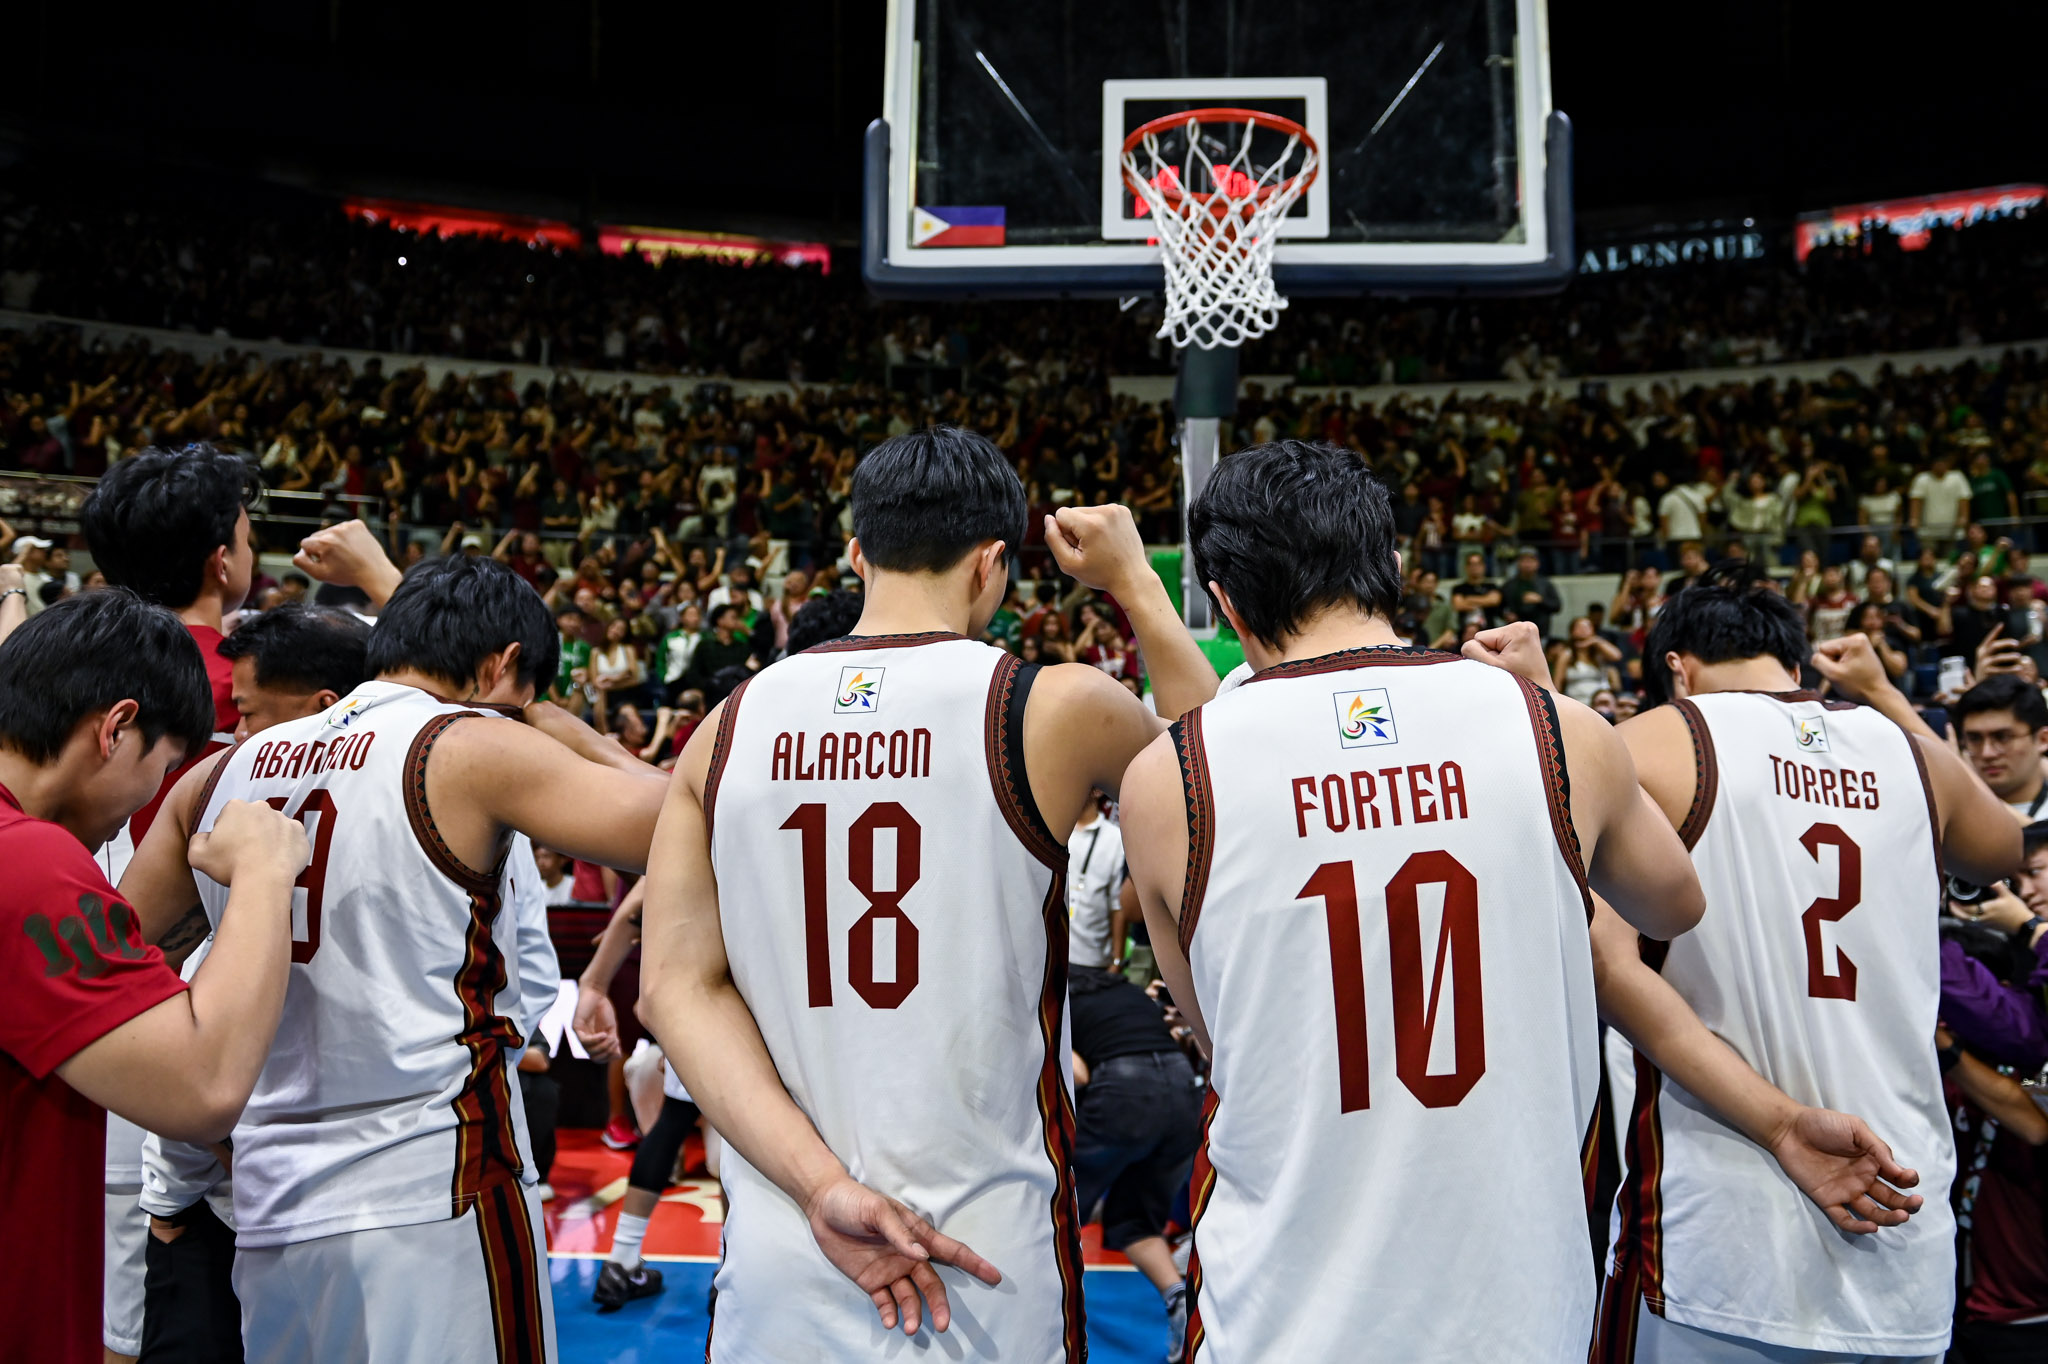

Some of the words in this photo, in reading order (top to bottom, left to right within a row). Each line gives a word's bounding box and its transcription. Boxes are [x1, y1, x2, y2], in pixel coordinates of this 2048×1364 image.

[771, 728, 932, 781] ALARCON
[1291, 760, 1469, 838] FORTEA
[1768, 753, 1881, 811] TORRES
[264, 788, 339, 966] 9
[778, 801, 922, 1010] 18
[1798, 822, 1862, 1002] 2
[1294, 849, 1487, 1115] 10
